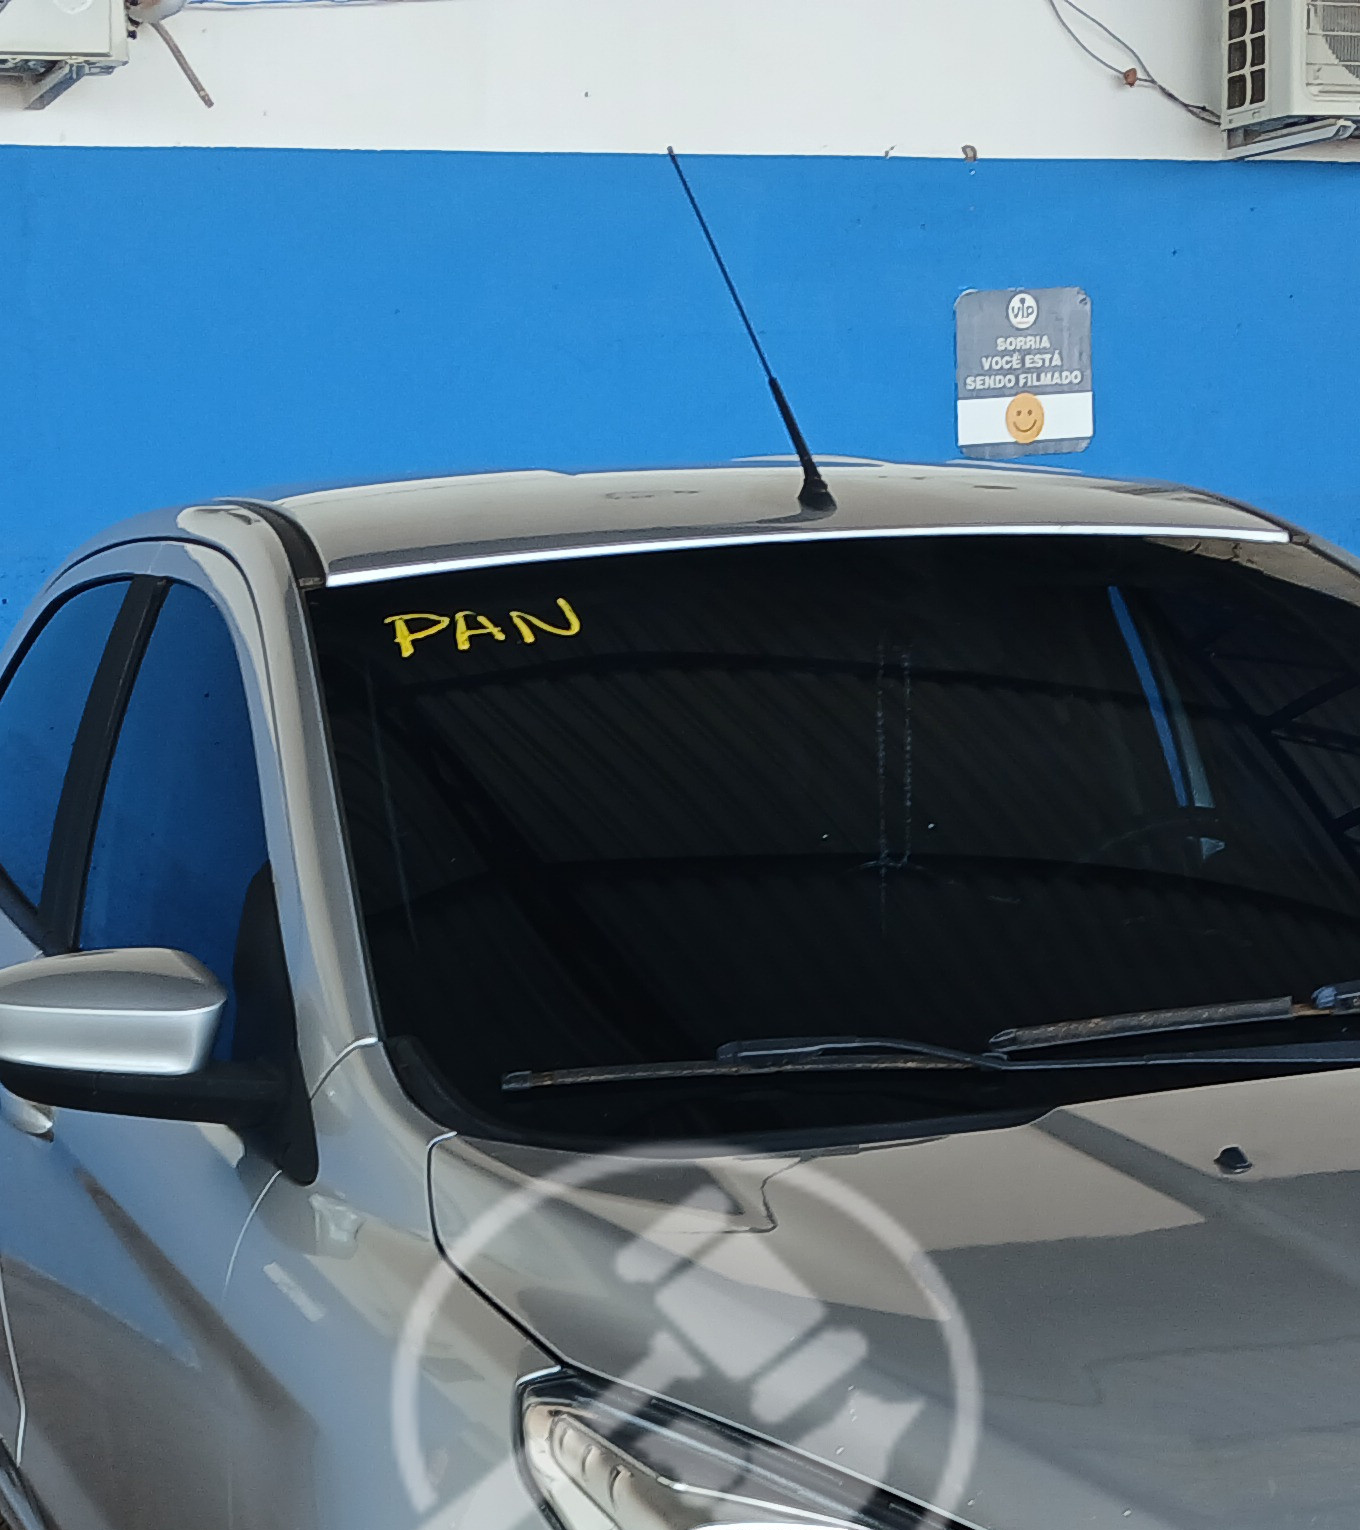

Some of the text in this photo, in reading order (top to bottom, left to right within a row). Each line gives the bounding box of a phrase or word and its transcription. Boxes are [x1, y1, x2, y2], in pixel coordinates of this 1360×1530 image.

[996, 334, 1050, 351] SORRIA
[981, 350, 1062, 371] VOCÊ ESTÁ
[965, 370, 1082, 390] SENDO FILMADO
[383, 597, 581, 658] PAN
